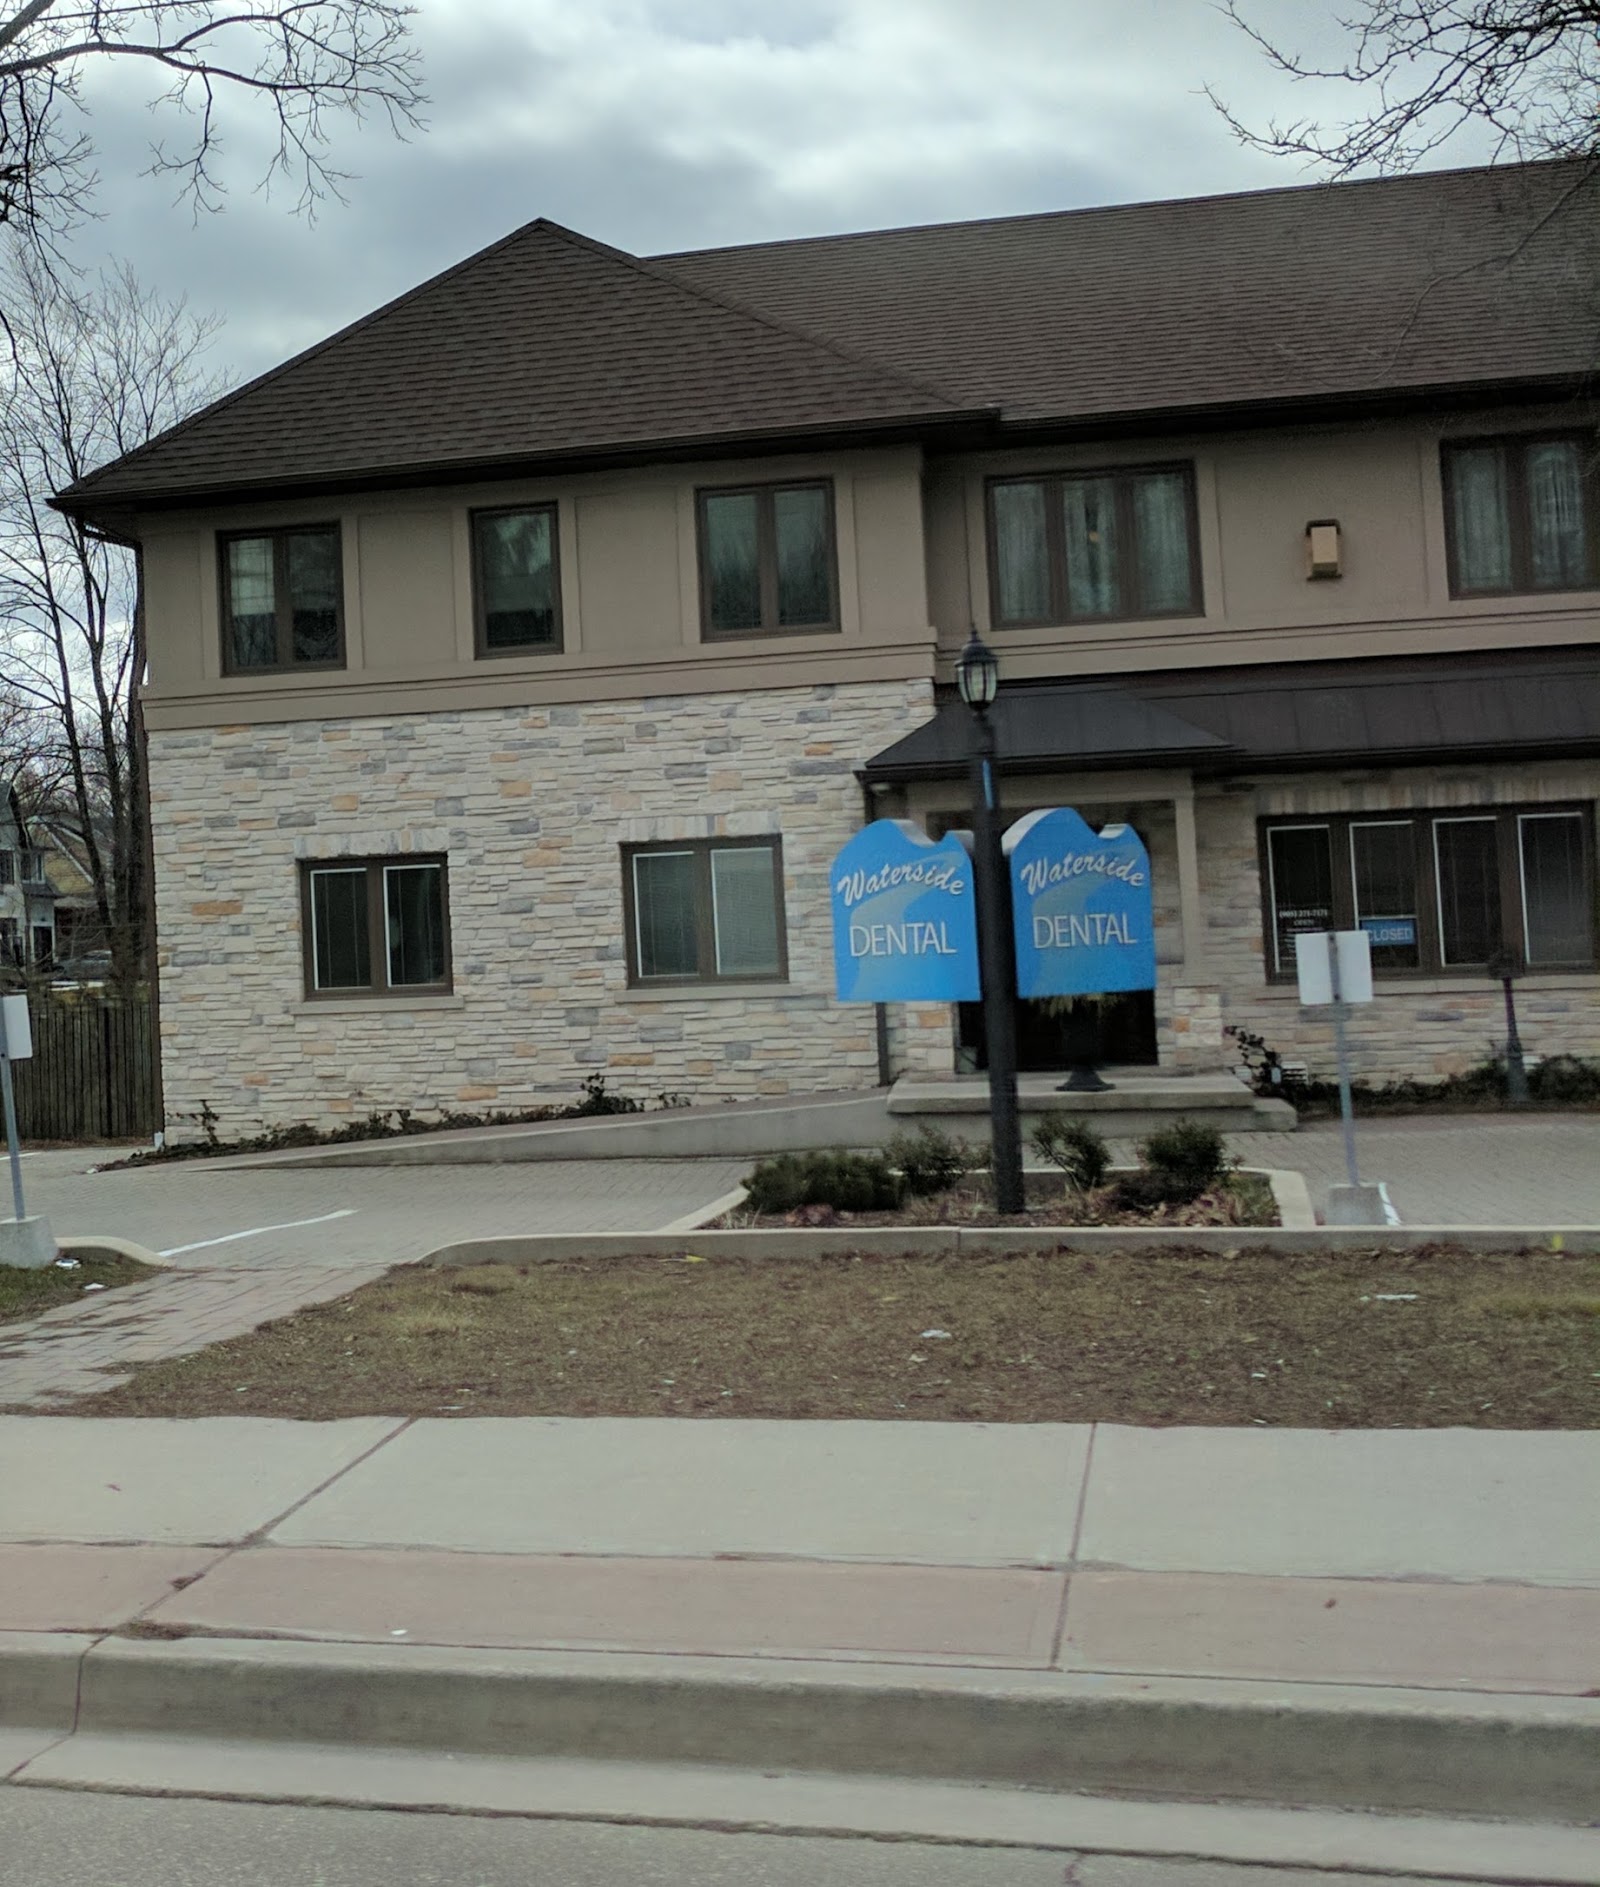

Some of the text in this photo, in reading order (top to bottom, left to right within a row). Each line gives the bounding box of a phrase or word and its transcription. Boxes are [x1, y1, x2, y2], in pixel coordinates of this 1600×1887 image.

[837, 863, 965, 906] Waterside
[1021, 853, 1144, 895] Waterside
[849, 921, 957, 957] DENTAL
[1032, 912, 1138, 949] DENTAL
